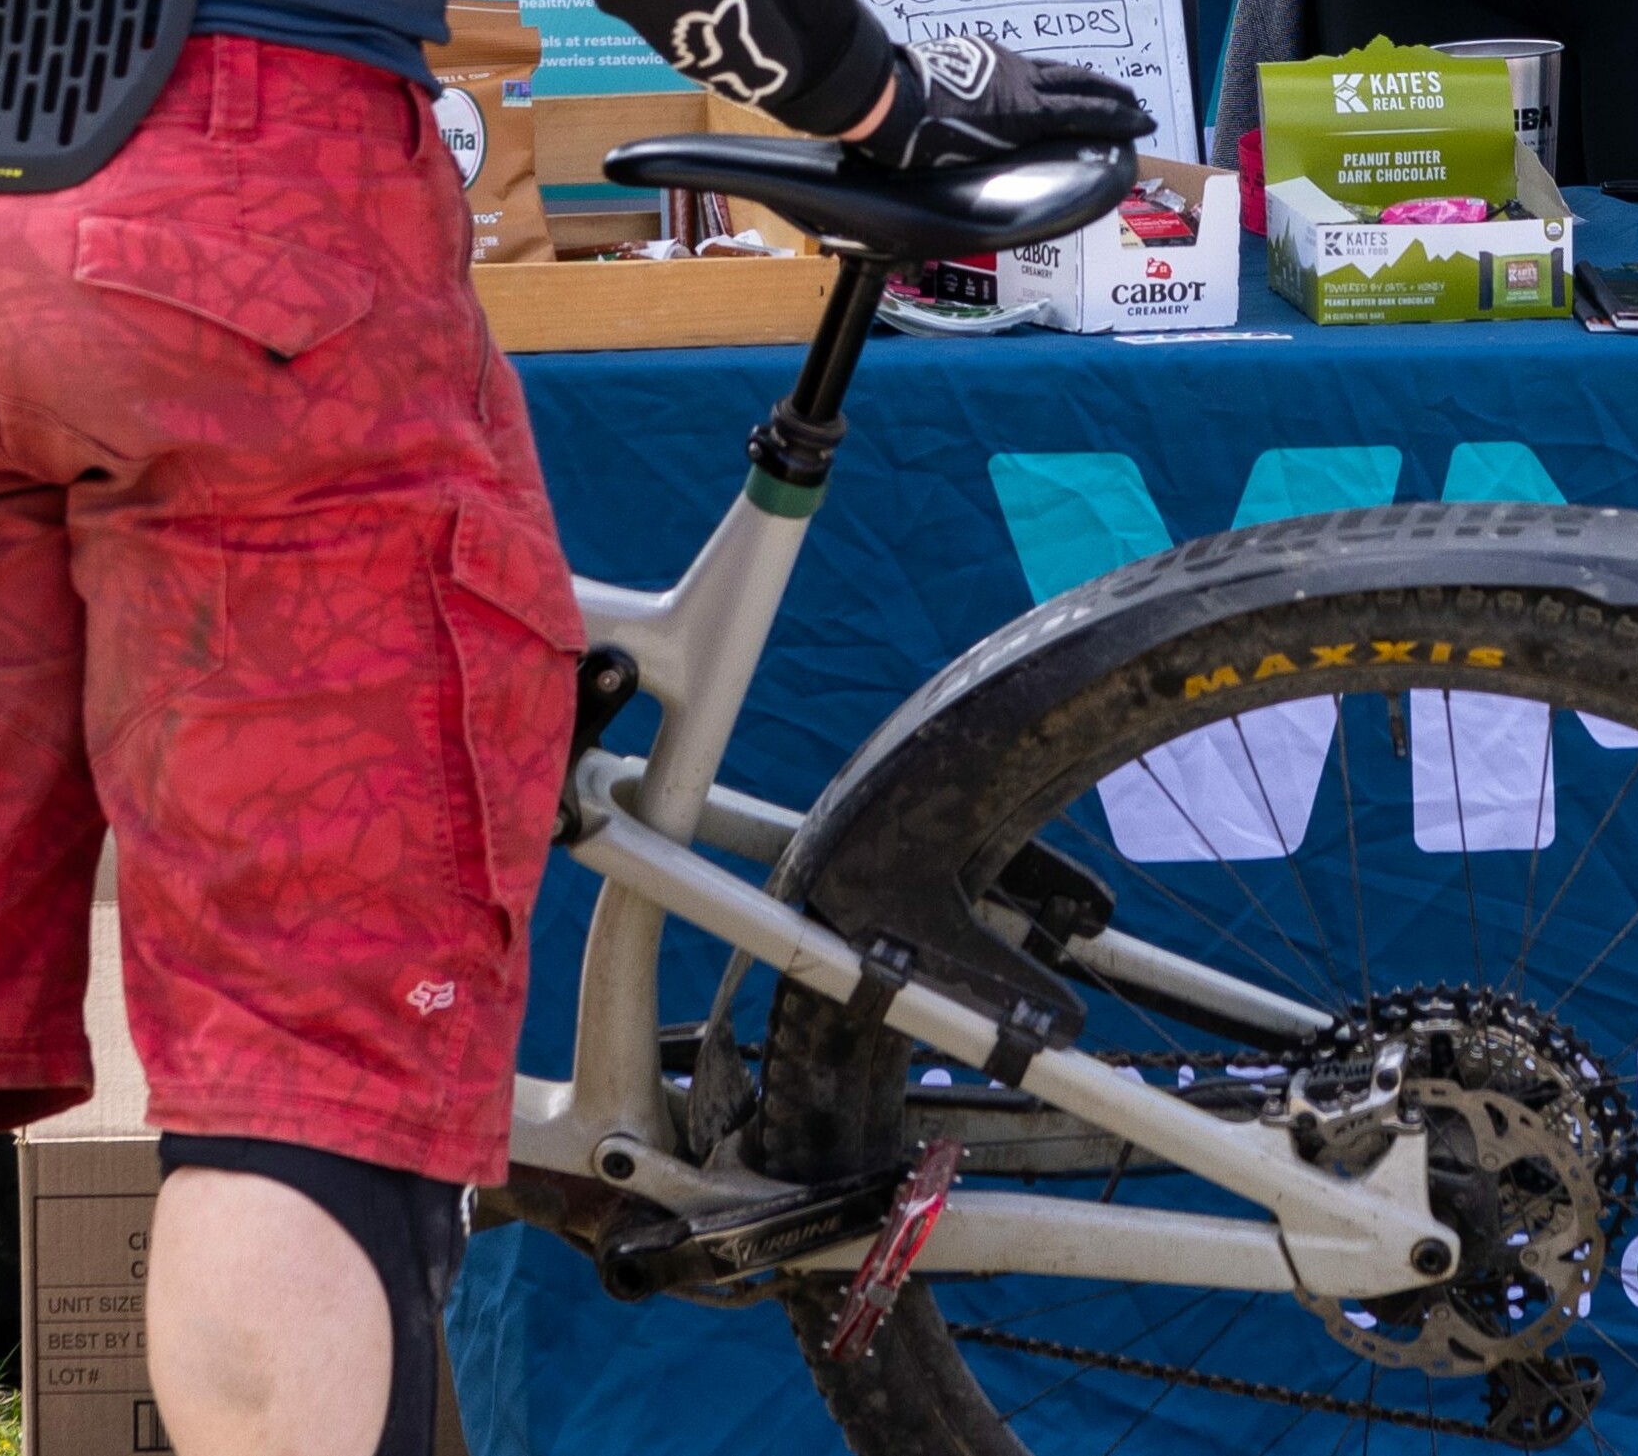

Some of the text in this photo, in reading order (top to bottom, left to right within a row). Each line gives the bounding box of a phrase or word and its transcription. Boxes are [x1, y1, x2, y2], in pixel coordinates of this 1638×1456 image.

[565, 37, 582, 47] at
[1369, 71, 1442, 95] KATE'S
[1373, 96, 1444, 111] REAL FOOD
[1343, 150, 1441, 167] PEANUT BUTTER
[1338, 165, 1447, 184] DARK CHOCOLATE
[1346, 232, 1389, 246] KATE'S
[1347, 246, 1389, 256] REAL FOOD
[1021, 264, 1053, 280] CREAMERY
[1324, 296, 1436, 307] PEANUT BUTTER DARK CHOCOLATE
[1127, 305, 1189, 317] CREAMERY
[1184, 640, 1505, 700] MAXXIS
[48, 1295, 143, 1314] UNIT SIZE
[48, 1333, 130, 1350] BEST BY
[48, 1368, 99, 1385] LOT#
